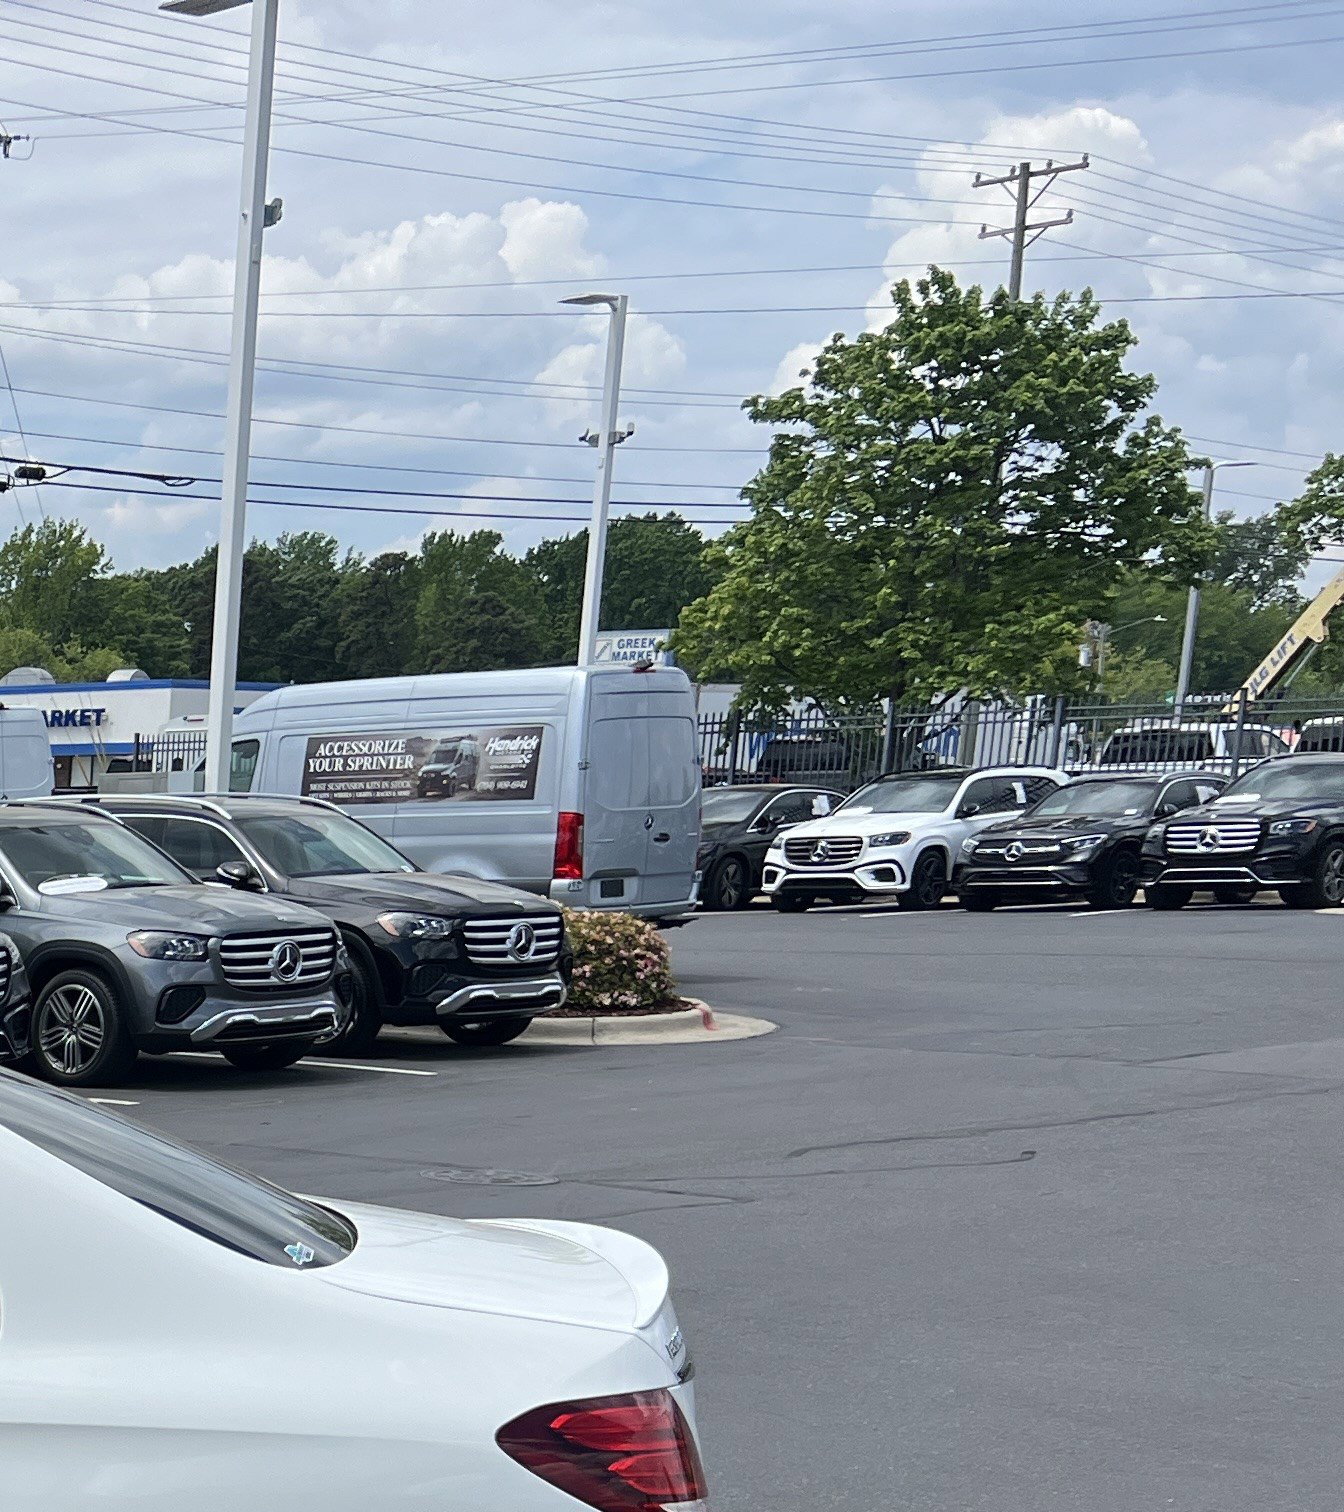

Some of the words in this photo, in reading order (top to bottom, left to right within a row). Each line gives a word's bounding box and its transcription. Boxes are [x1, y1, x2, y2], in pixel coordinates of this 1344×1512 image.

[617, 638, 656, 649] GREEK
[1270, 633, 1296, 668] LIFT
[612, 650, 659, 661] MARKET
[316, 739, 408, 757] ACCESSORIZE
[485, 735, 540, 755] Hendrick
[308, 758, 343, 773] YOUR
[345, 755, 414, 772] SPRINTER
